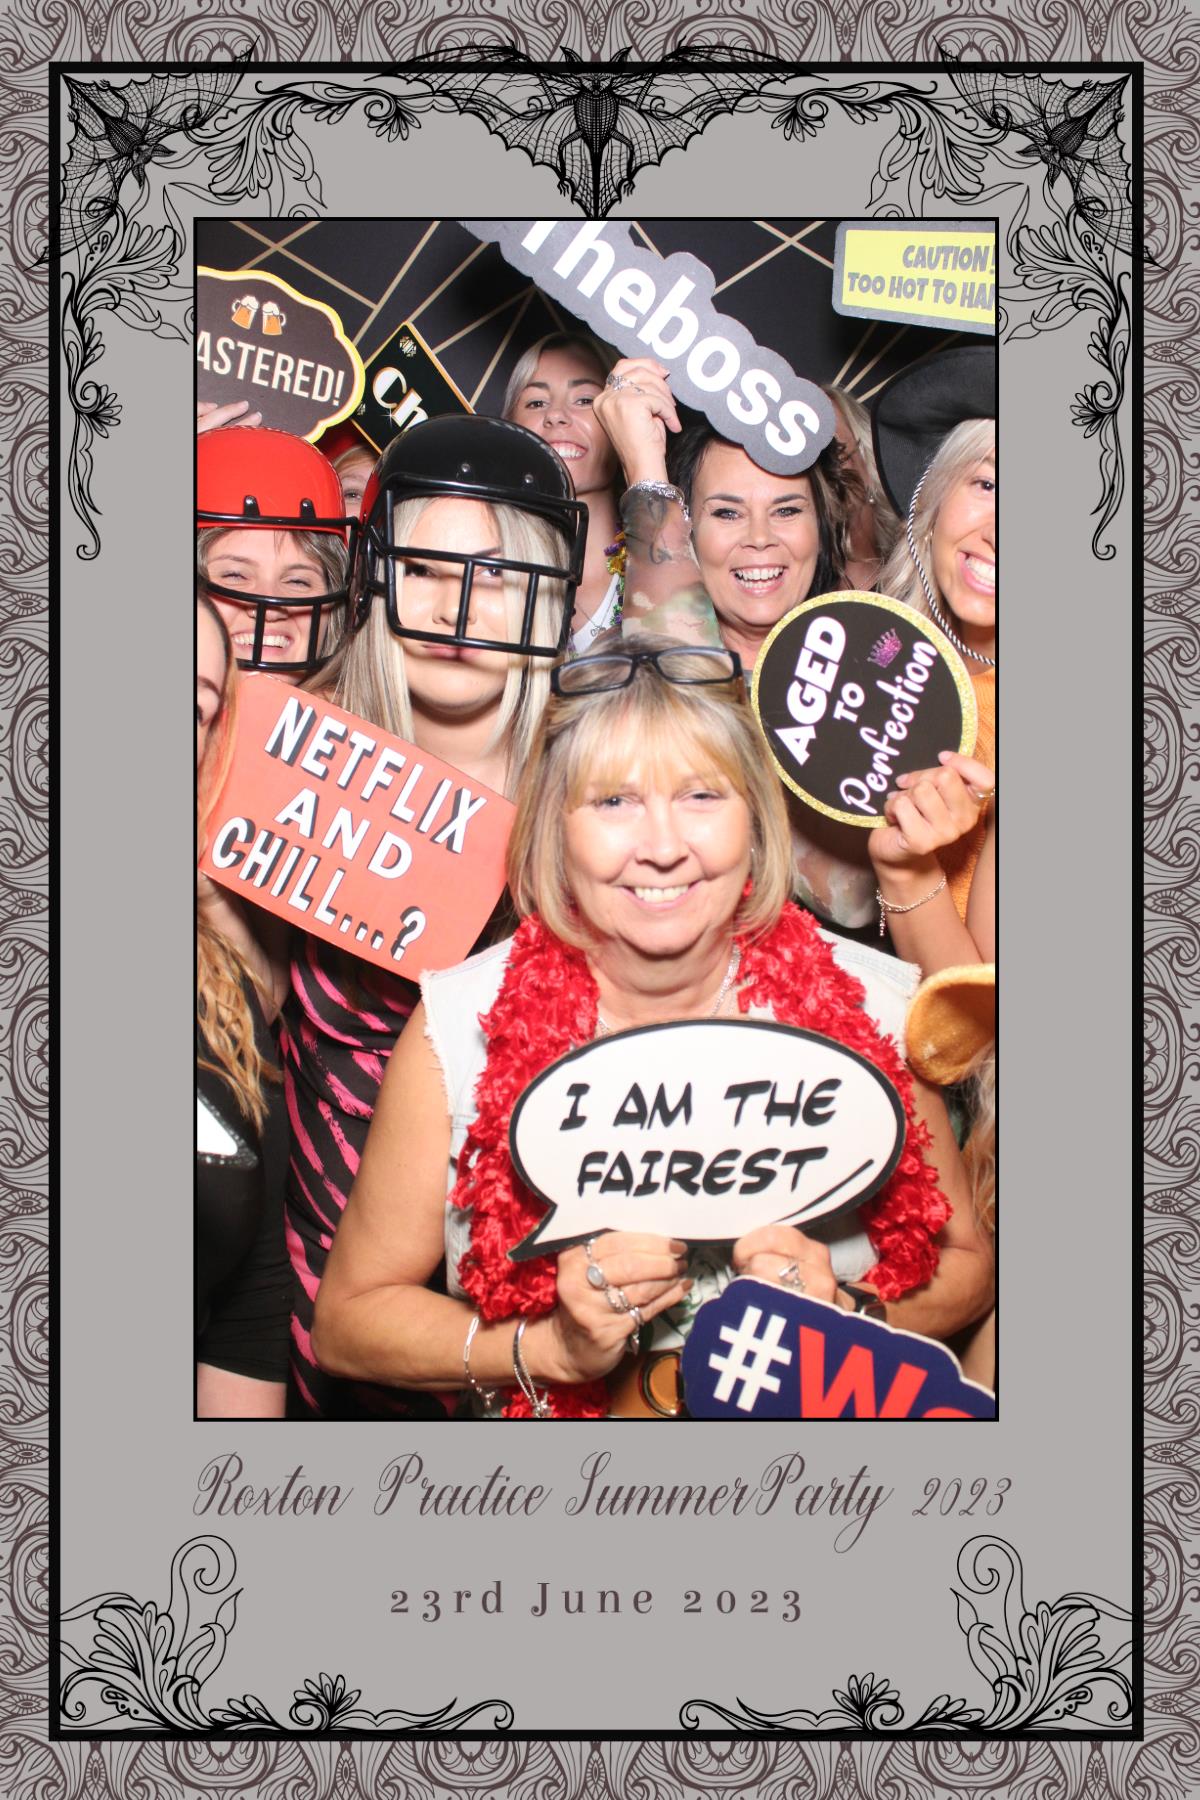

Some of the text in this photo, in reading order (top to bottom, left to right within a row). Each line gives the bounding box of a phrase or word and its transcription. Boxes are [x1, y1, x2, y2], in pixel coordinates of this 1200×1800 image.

[847, 272, 886, 295] TOO
[888, 276, 929, 301] HOT
[932, 279, 957, 304] TO
[902, 245, 995, 275] CAUTION!
[775, 616, 846, 766] AGED
[833, 681, 865, 723] TO
[839, 640, 938, 815] Perfection
[264, 696, 487, 854] NETFLIX
[274, 788, 413, 879] AND
[211, 816, 427, 961] CHILL...?
[559, 1078, 842, 1131] I AM THE
[577, 1146, 829, 1197] FAIREST
[708, 1305, 978, 1418] #W
